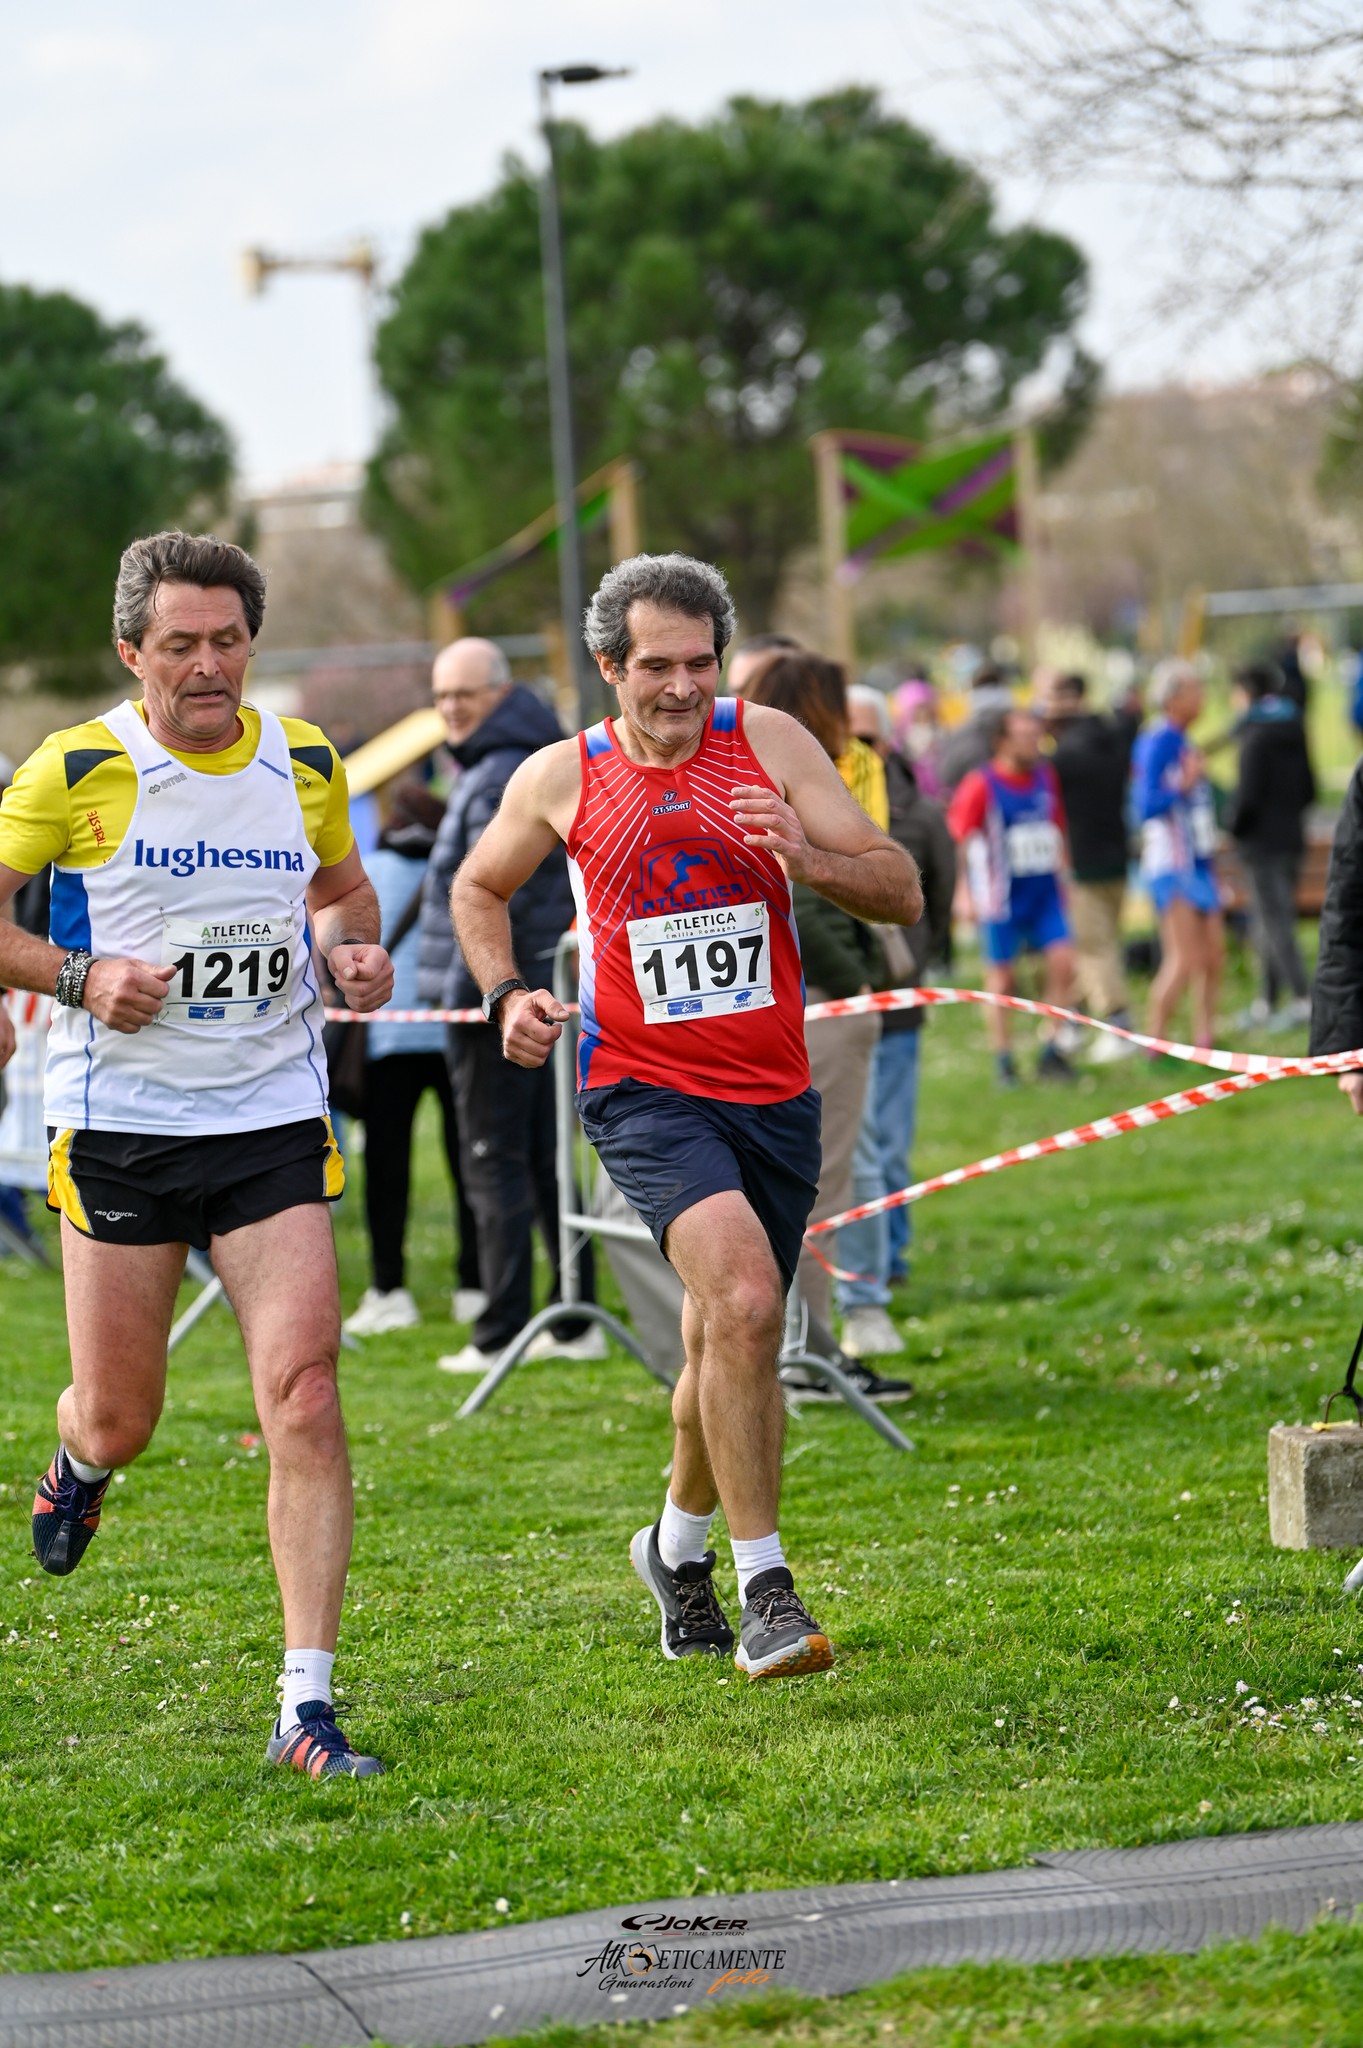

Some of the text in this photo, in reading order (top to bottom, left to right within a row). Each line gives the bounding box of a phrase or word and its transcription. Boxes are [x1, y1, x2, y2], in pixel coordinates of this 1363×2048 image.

[665, 802, 689, 812] SPORT
[87, 810, 106, 847] TRIESTE
[134, 839, 305, 877] lughesina
[643, 884, 745, 914] ATLETICA
[201, 923, 271, 938] ATLETICA
[664, 912, 737, 932] ATLETICA
[666, 925, 736, 939] Emilia Romagna
[172, 947, 290, 998] 1219
[642, 934, 763, 996] 1197
[732, 1002, 752, 1010] KARHU
